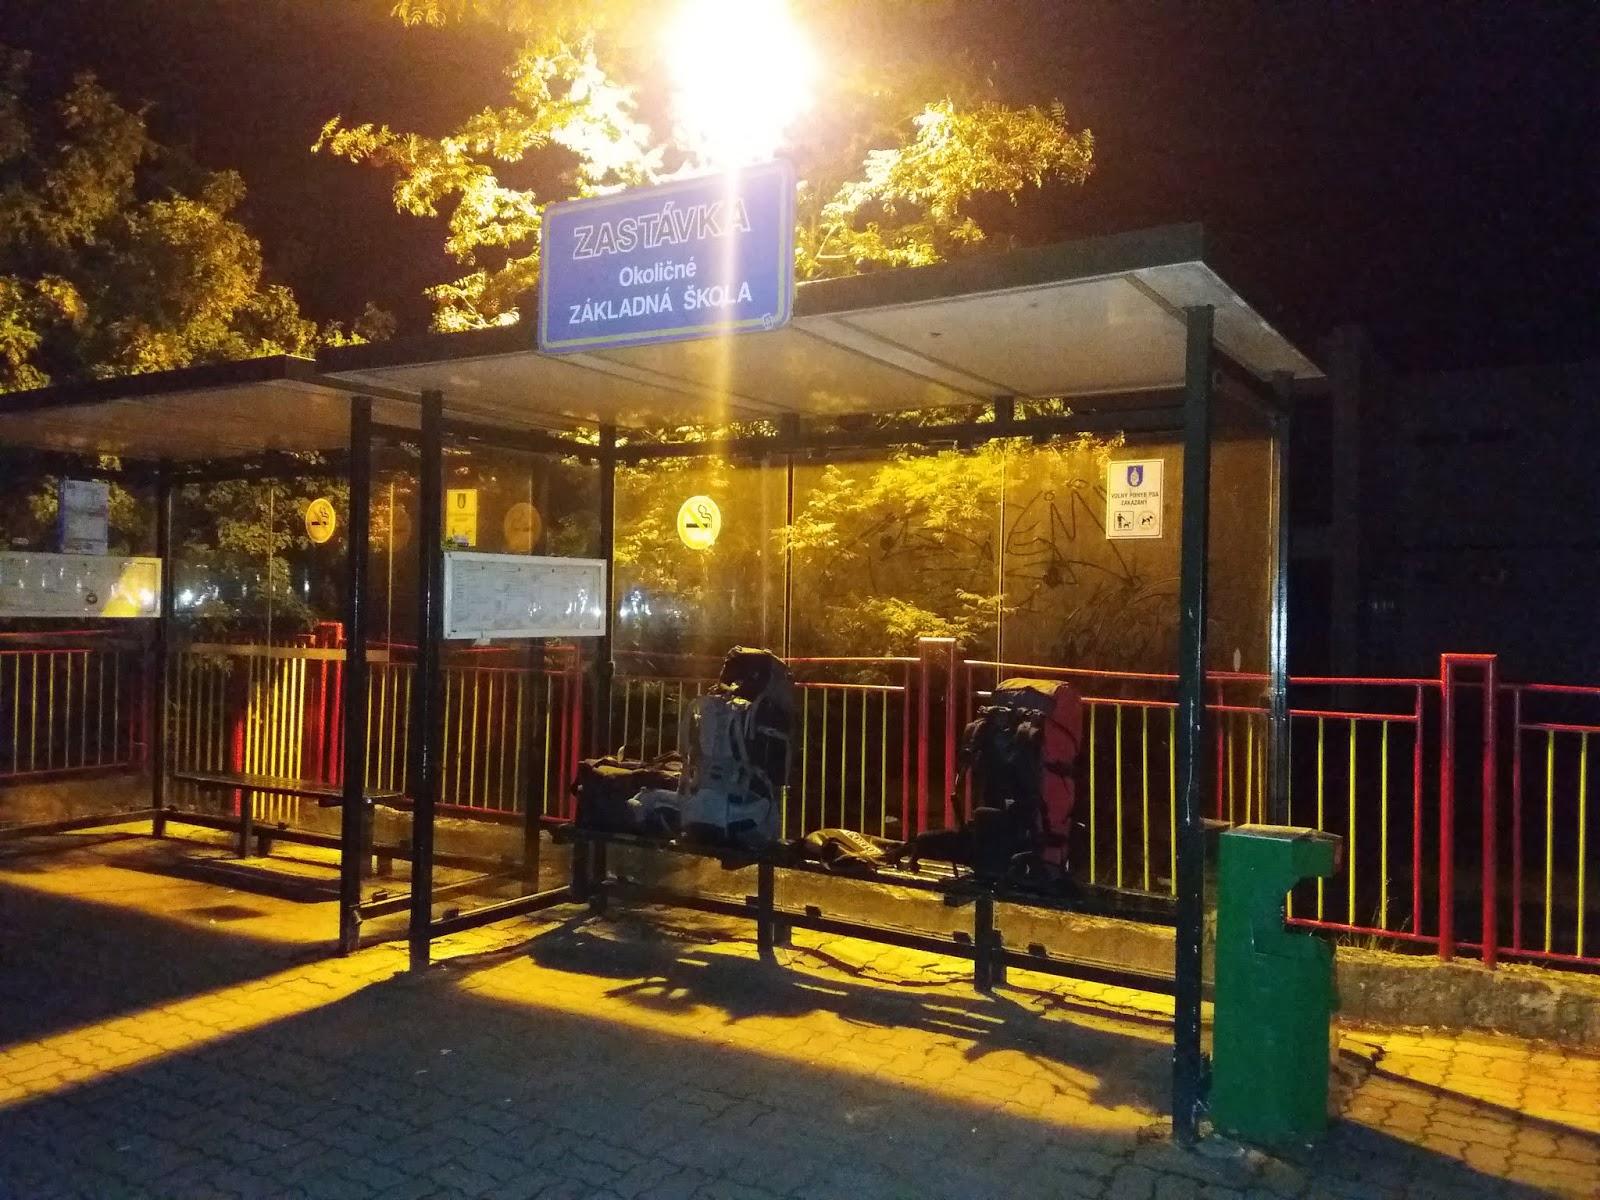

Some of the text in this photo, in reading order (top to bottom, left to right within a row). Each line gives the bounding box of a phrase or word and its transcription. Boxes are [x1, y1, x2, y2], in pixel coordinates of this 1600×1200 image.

[572, 197, 751, 260] ZASTÁVKA
[619, 256, 697, 288] Okoličné
[568, 281, 753, 325] ZÁKLADNÁ ŠKOLA
